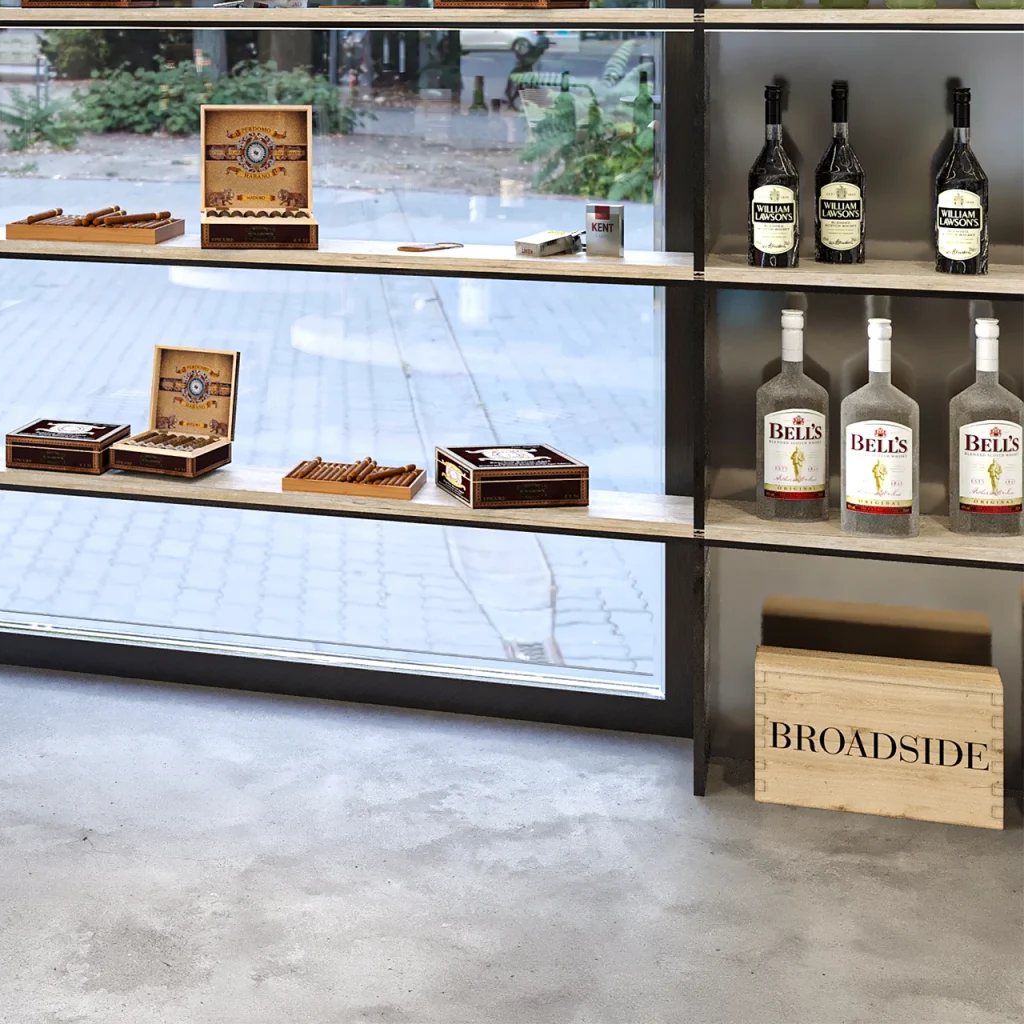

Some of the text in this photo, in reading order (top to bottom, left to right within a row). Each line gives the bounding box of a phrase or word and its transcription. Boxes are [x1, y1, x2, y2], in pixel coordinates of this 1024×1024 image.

[757, 204, 790, 213] WILLIAM
[824, 202, 857, 210] WILLIAM
[755, 212, 793, 222] LAWSON'S
[822, 210, 860, 218] LAWSON'S
[941, 210, 975, 218] WILLIAM
[939, 217, 979, 227] LAWSON'S
[592, 223, 614, 232] KENT
[769, 422, 822, 440] BELL'S
[851, 434, 908, 454] BELL'S
[964, 434, 1019, 452] BELL'S
[769, 720, 990, 771] BROADSIDE
